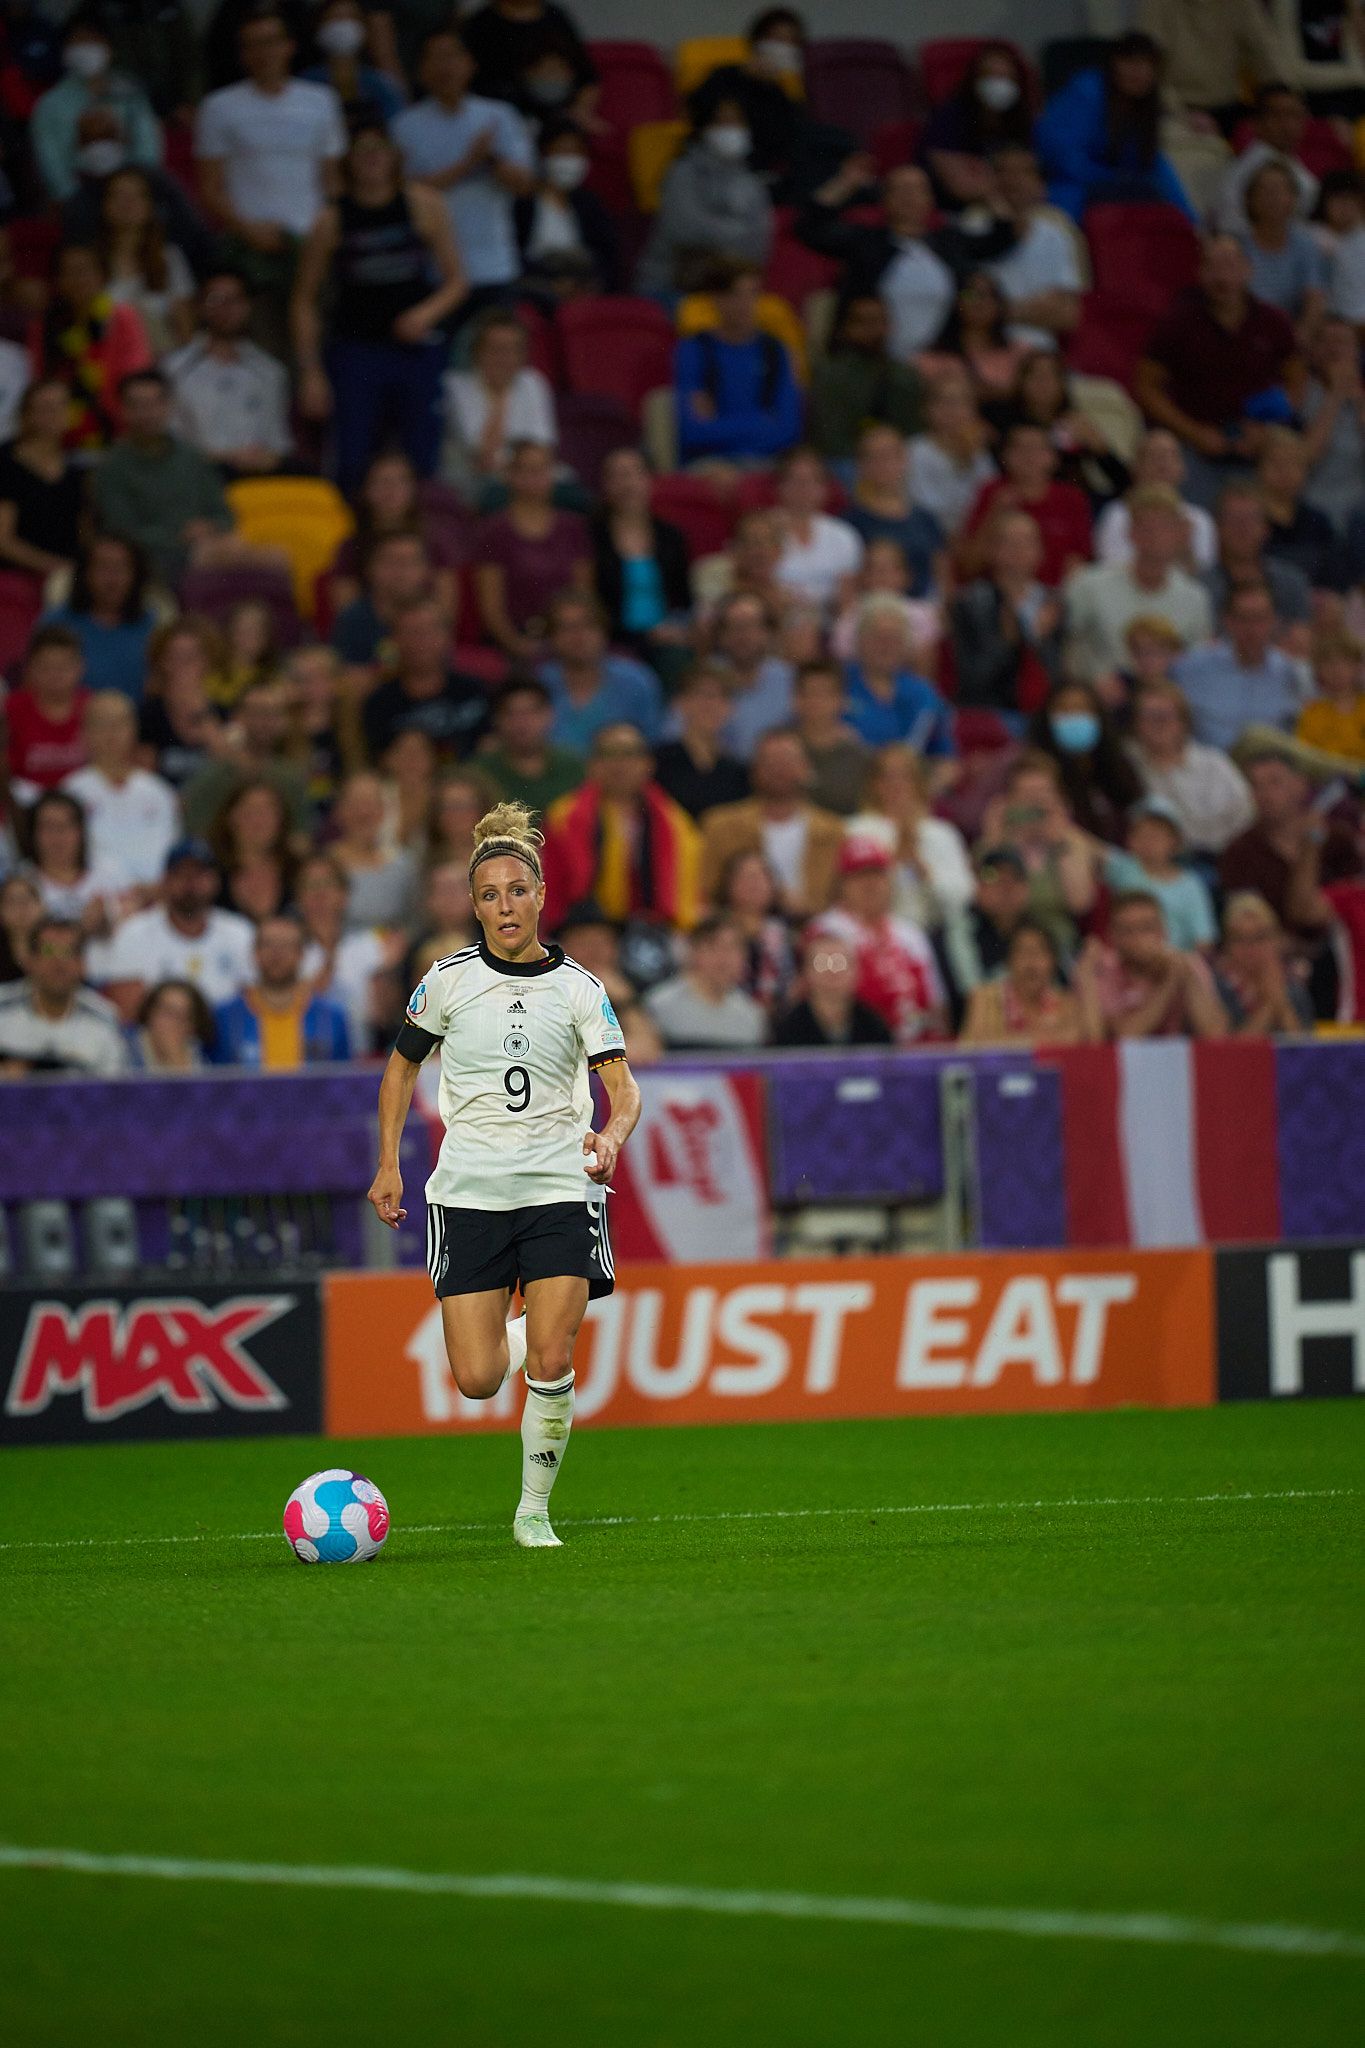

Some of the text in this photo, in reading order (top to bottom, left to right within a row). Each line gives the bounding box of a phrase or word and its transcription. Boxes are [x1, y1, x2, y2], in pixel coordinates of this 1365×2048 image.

[504, 1065, 531, 1113] 9
[5, 1294, 297, 1423] MAX
[574, 1272, 1139, 1421] JUST EAT
[1266, 1252, 1365, 1395] H
[529, 1454, 559, 1467] adidas
